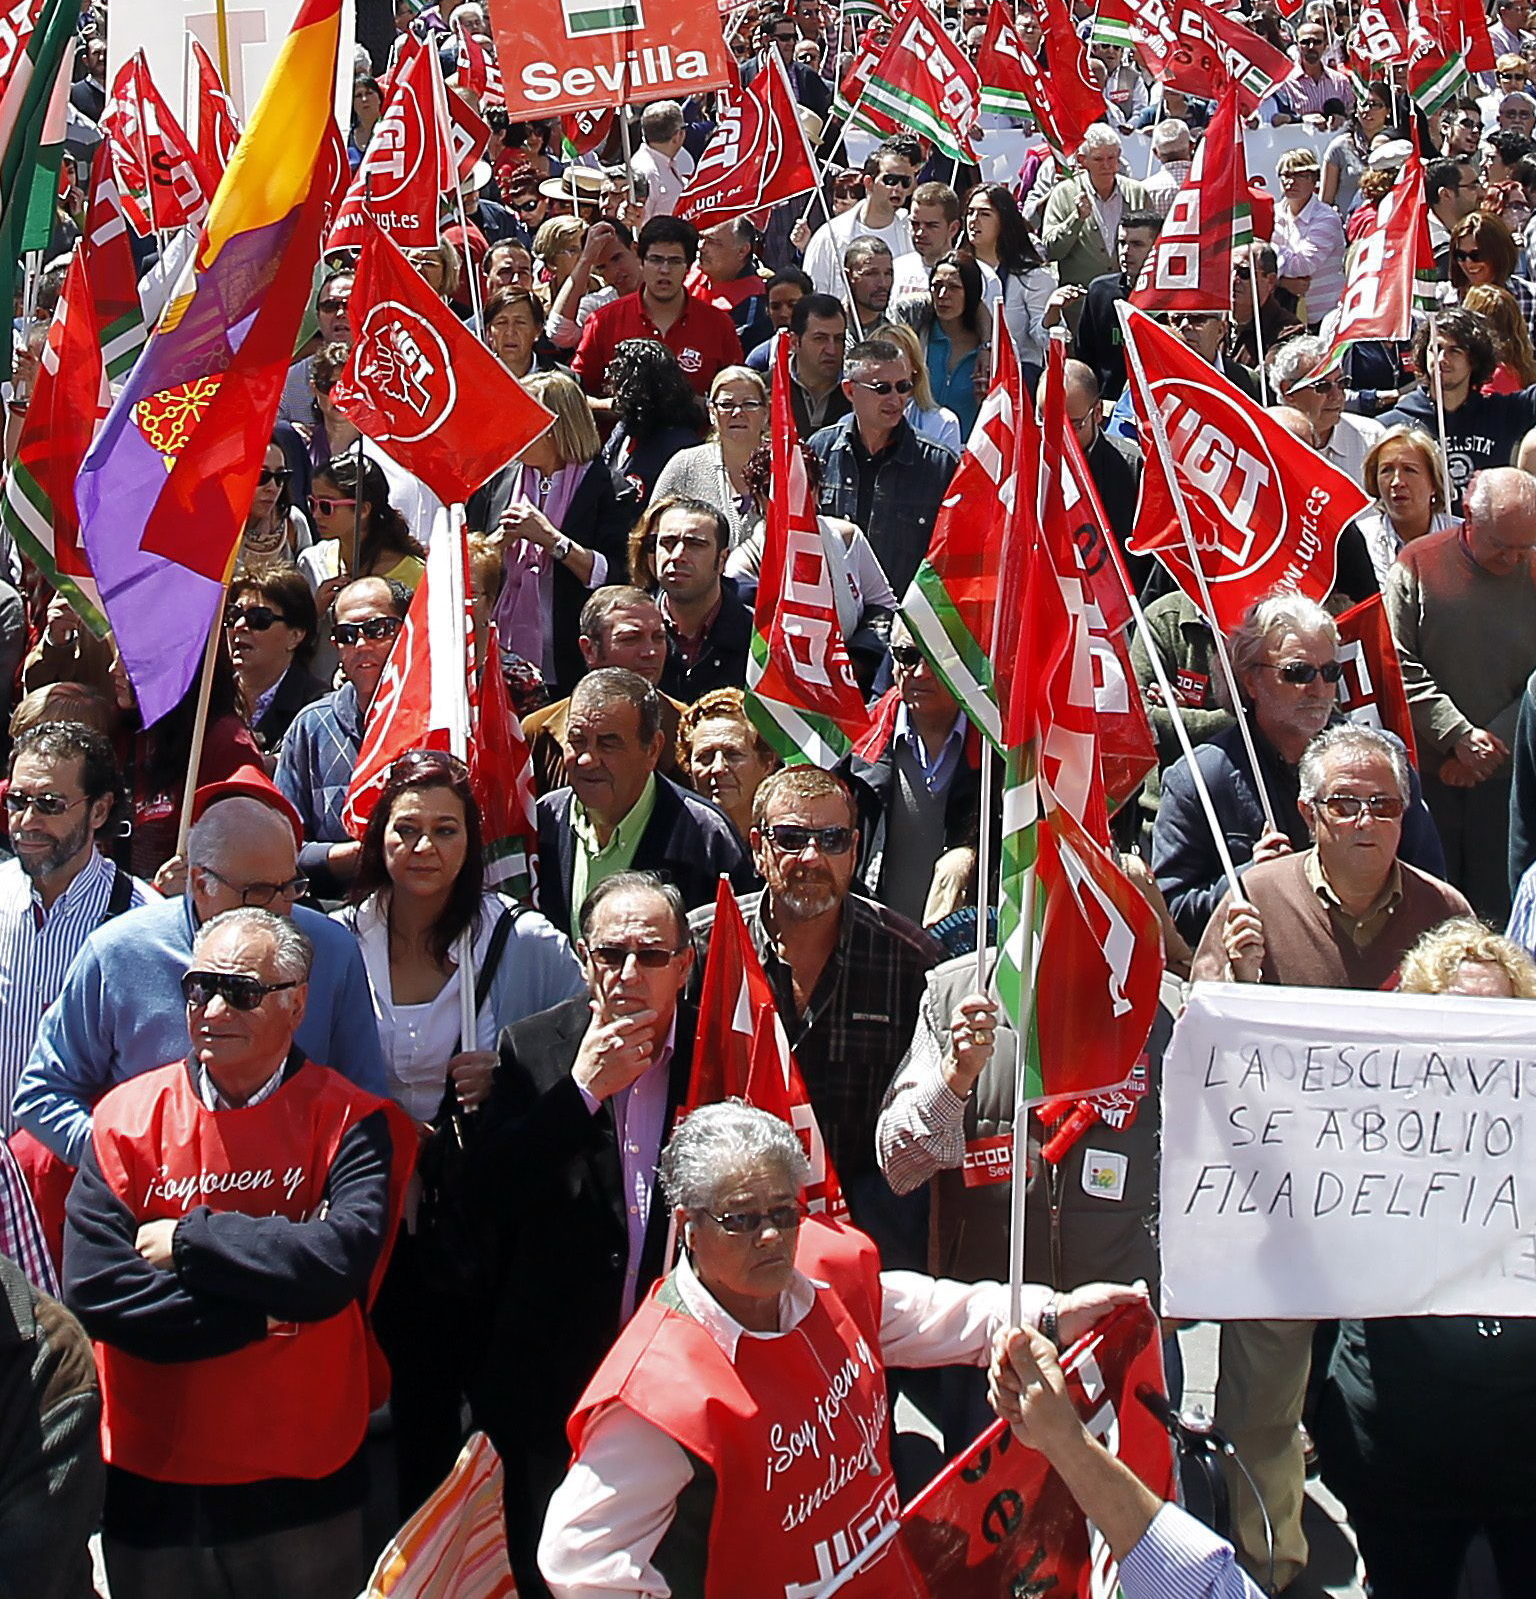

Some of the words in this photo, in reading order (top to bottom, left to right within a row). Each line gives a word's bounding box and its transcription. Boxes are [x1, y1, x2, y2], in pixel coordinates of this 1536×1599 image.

[521, 46, 709, 102] Sevilla
[1160, 392, 1270, 542] UGT
[1204, 1046, 1265, 1091] LA
[1229, 1106, 1293, 1147] SE
[1316, 1107, 1513, 1157] ABOLIO
[282, 1166, 305, 1199] y
